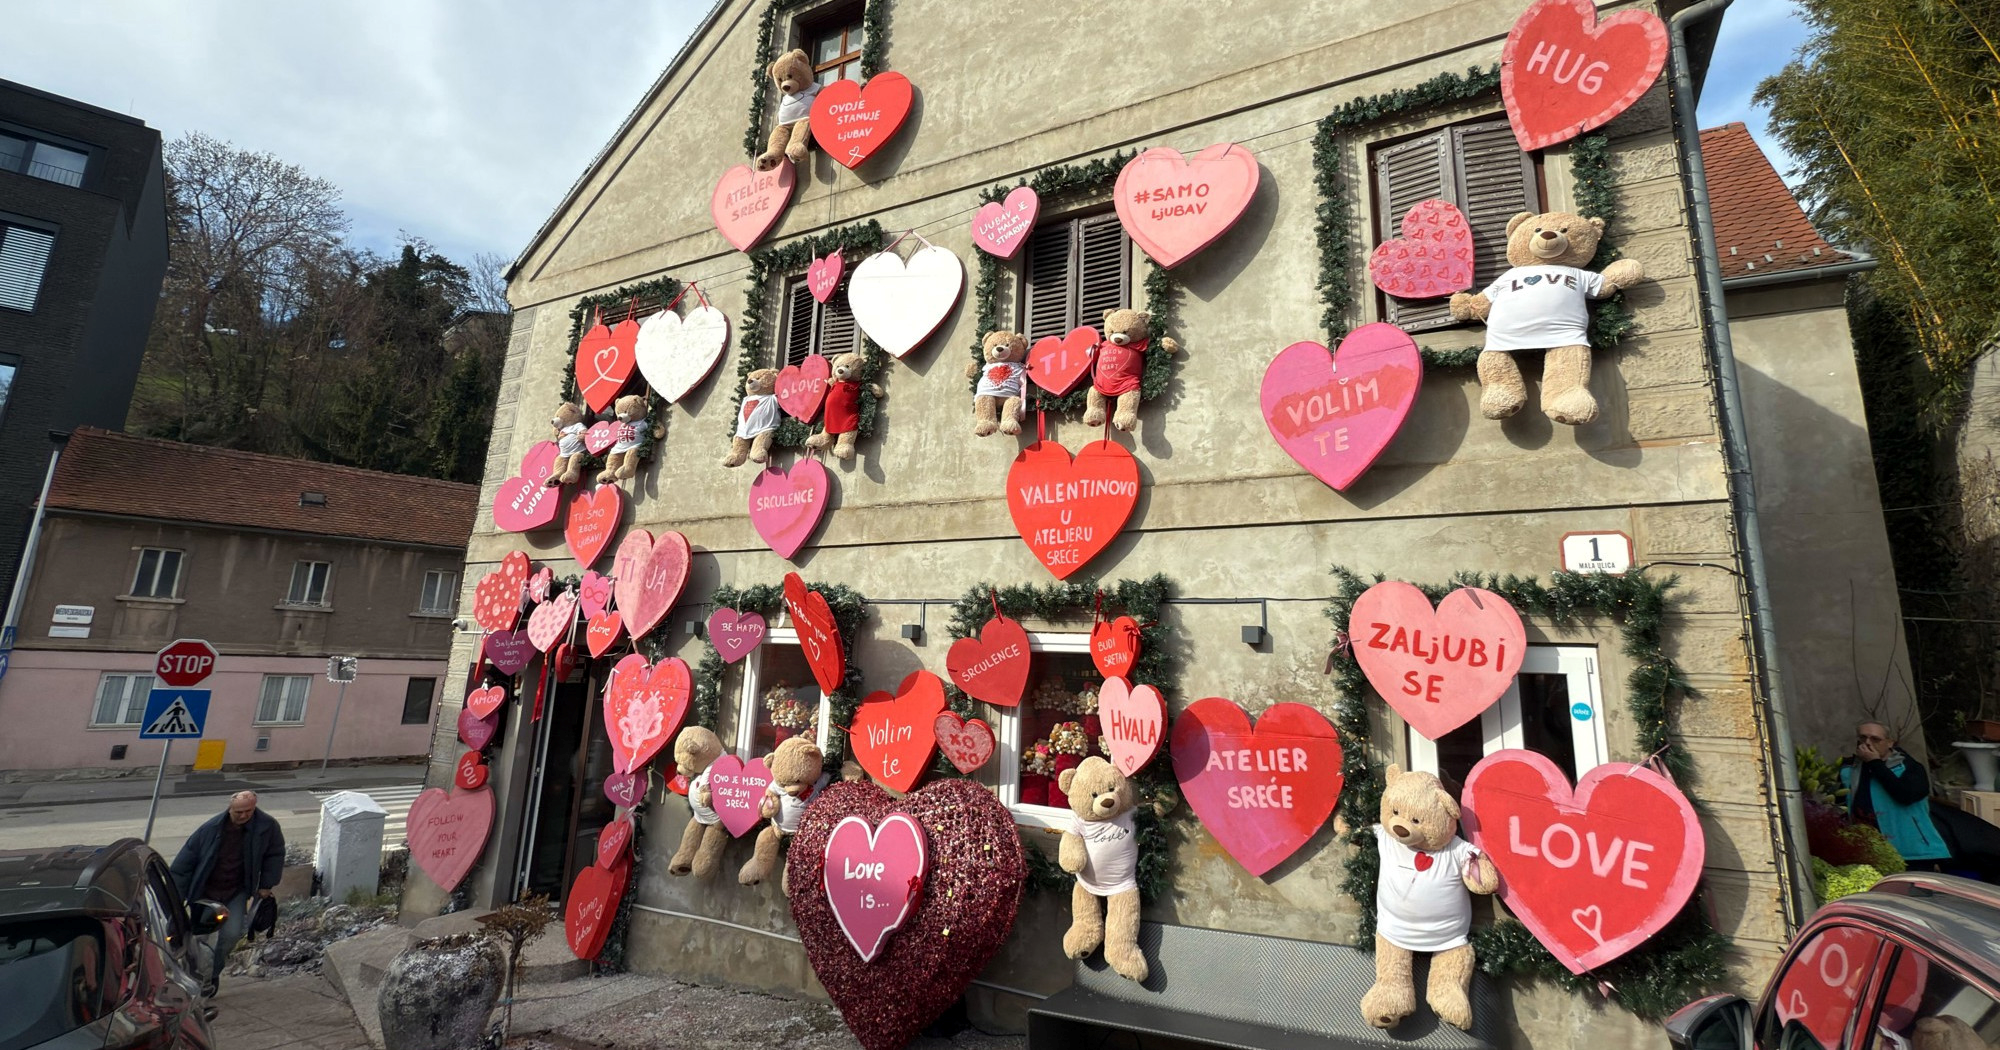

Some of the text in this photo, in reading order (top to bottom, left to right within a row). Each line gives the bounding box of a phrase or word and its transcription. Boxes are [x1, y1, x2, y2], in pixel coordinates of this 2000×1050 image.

[1526, 41, 1610, 95] HUG
[829, 100, 865, 115] OVDJE
[837, 110, 880, 125] STANUJE
[725, 176, 774, 209] ATELIER
[1134, 183, 1210, 204] #SAMO
[731, 195, 770, 222] SREĆE
[987, 232, 995, 241] U
[815, 268, 827, 280] TE
[816, 276, 836, 293] AMO
[791, 377, 821, 394] LOVE
[592, 430, 609, 438] XO
[1313, 427, 1350, 457] TE
[592, 439, 610, 449] XO
[511, 479, 535, 511] BUDI
[756, 488, 814, 512] SRCULENCE
[1020, 479, 1137, 506] VALENTINOVO
[587, 508, 605, 519] SMO
[1060, 509, 1072, 525] U
[1034, 526, 1093, 547] ATELIERU
[1046, 544, 1079, 566] SREĆE
[1589, 537, 1603, 561] 1
[621, 557, 667, 593] TI JA
[721, 623, 733, 632] BE
[1097, 637, 1116, 652] BUDI
[159, 655, 213, 674] STOP
[961, 643, 1021, 683] SRCULENCE
[1103, 652, 1128, 668] SRETAN
[1402, 671, 1444, 704] SE
[473, 694, 500, 706] AMOR
[867, 718, 912, 749] Volim
[950, 733, 976, 749] XO
[882, 754, 901, 778] te
[956, 750, 980, 765] XO
[1205, 748, 1308, 773] ATELIER
[462, 760, 478, 785] YOU
[731, 776, 738, 784] JE
[742, 777, 767, 787] MJESTO
[611, 782, 625, 793] MIR
[718, 787, 733, 796] GDJE
[1227, 777, 1293, 809] SREĆE
[428, 814, 464, 828] FOLLOW
[438, 831, 457, 842] YOUR
[602, 828, 624, 854] SRCE
[432, 847, 456, 858] HEART
[1509, 815, 1654, 889] LOVE
[844, 857, 885, 881] Love
